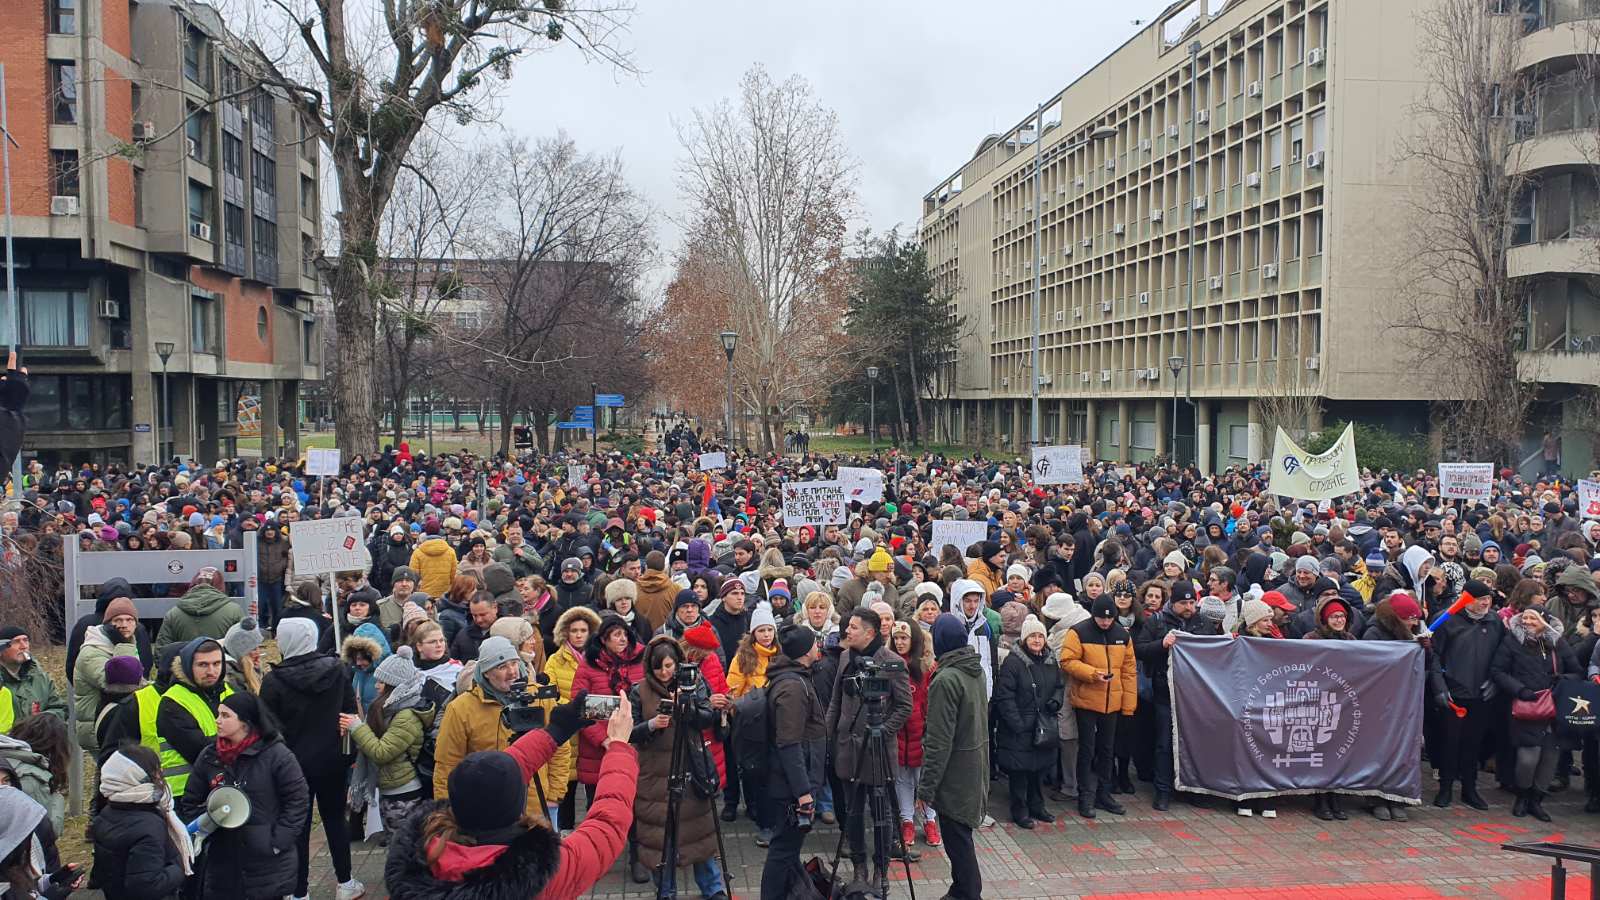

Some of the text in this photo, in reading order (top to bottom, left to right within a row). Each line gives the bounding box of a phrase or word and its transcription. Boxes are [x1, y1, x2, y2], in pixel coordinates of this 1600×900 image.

[1257, 663, 1314, 686] Београду
[1321, 665, 1360, 707] Хемијски
[1336, 708, 1363, 759] факултет
